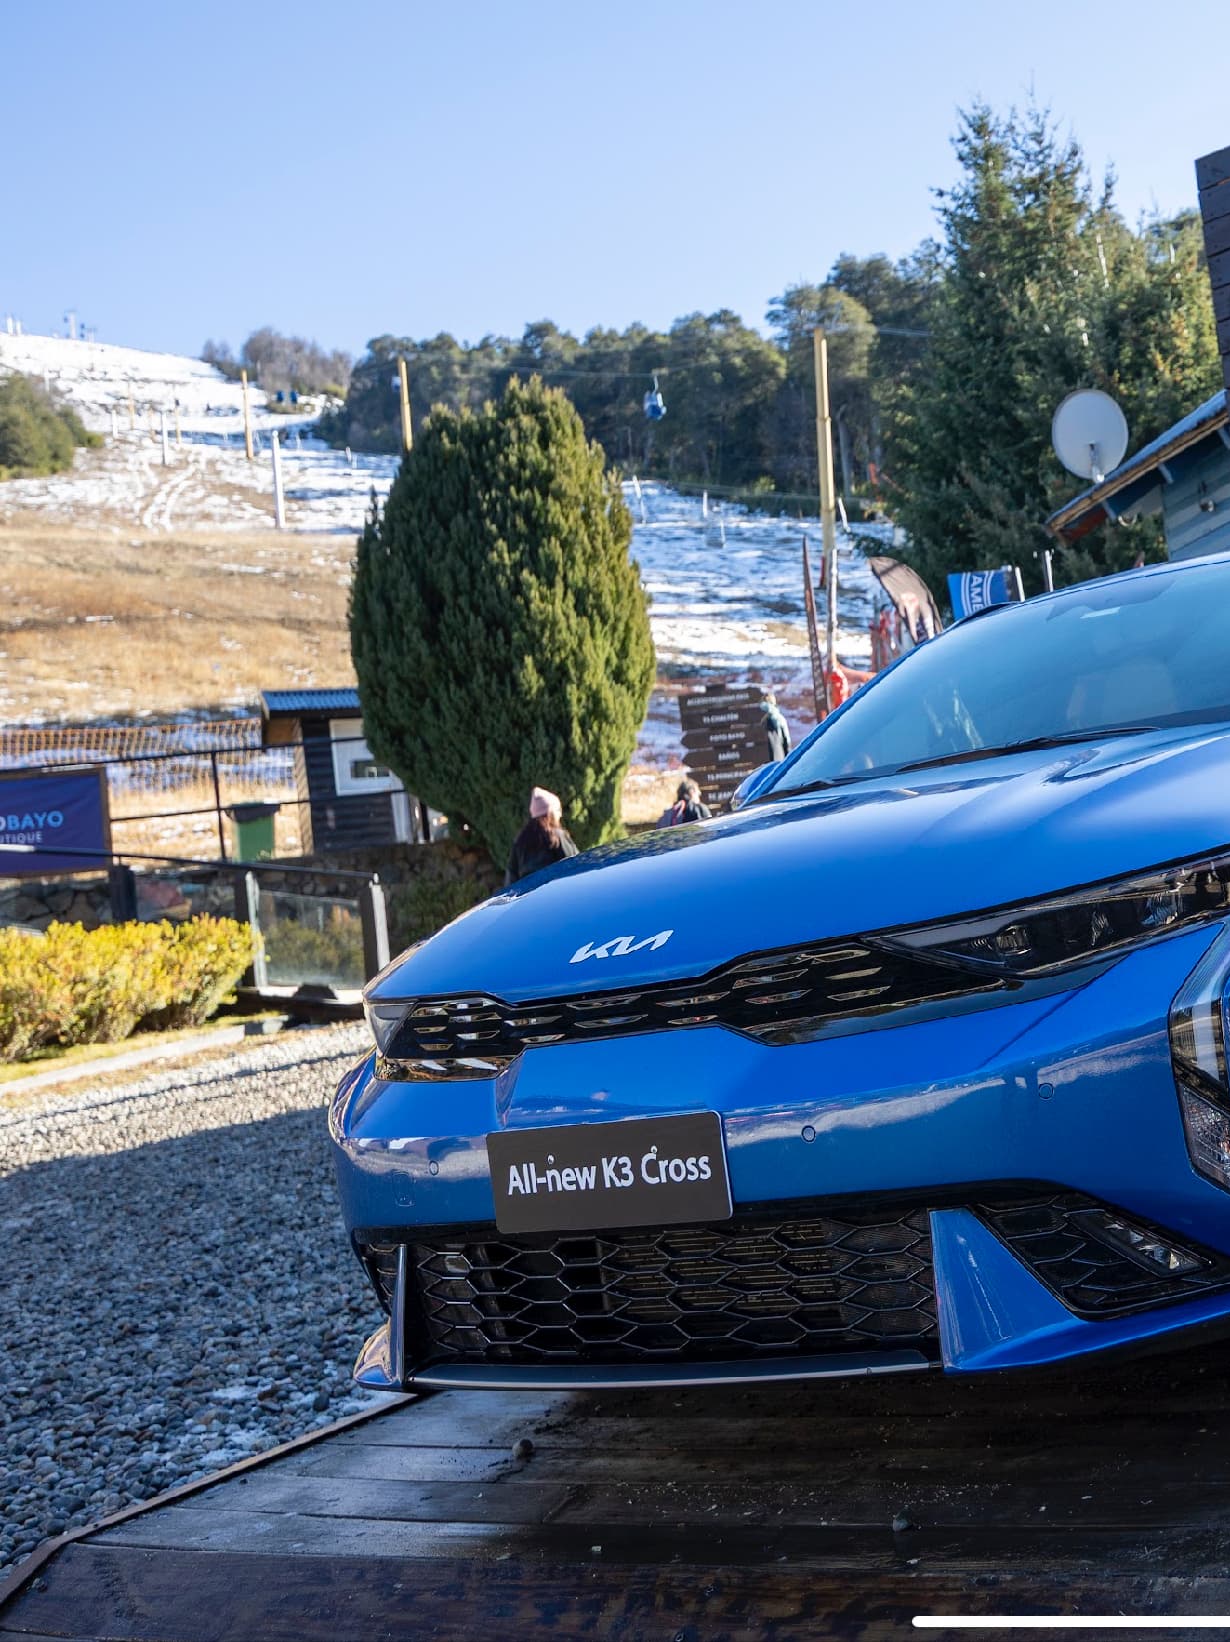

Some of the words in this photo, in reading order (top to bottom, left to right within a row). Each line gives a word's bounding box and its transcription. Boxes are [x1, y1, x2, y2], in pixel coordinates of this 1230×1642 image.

[569, 929, 674, 964] KIA
[508, 1162, 596, 1195] All-new
[602, 1156, 634, 1188] K3
[641, 1152, 711, 1185] Cross
